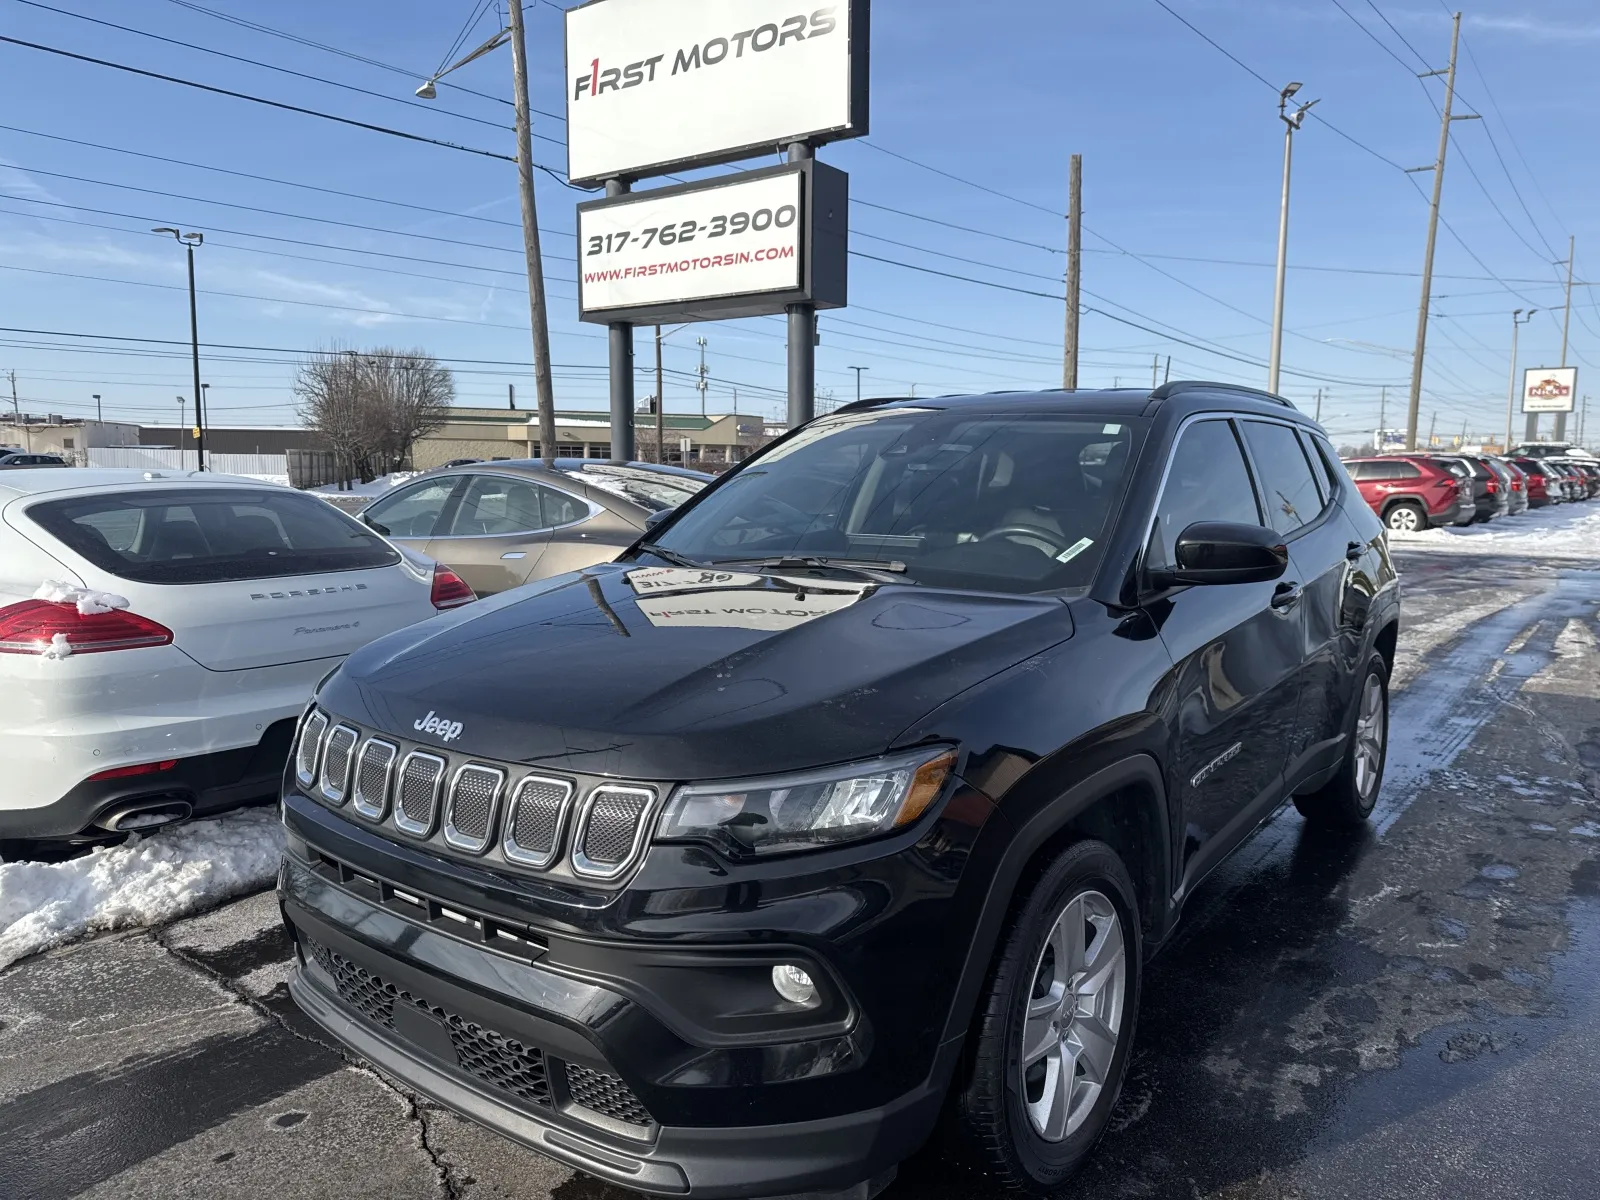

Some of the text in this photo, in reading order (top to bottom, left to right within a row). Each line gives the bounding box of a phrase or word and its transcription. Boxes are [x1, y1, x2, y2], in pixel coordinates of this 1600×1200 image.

[671, 6, 837, 76] MOTORS
[586, 205, 796, 257] 317-762-3900
[584, 246, 794, 284] WWW.FIRSTMOTORSIN.COM
[249, 583, 368, 600] PORSCHE
[293, 623, 350, 636] Panamera
[413, 710, 464, 742] Jeep
